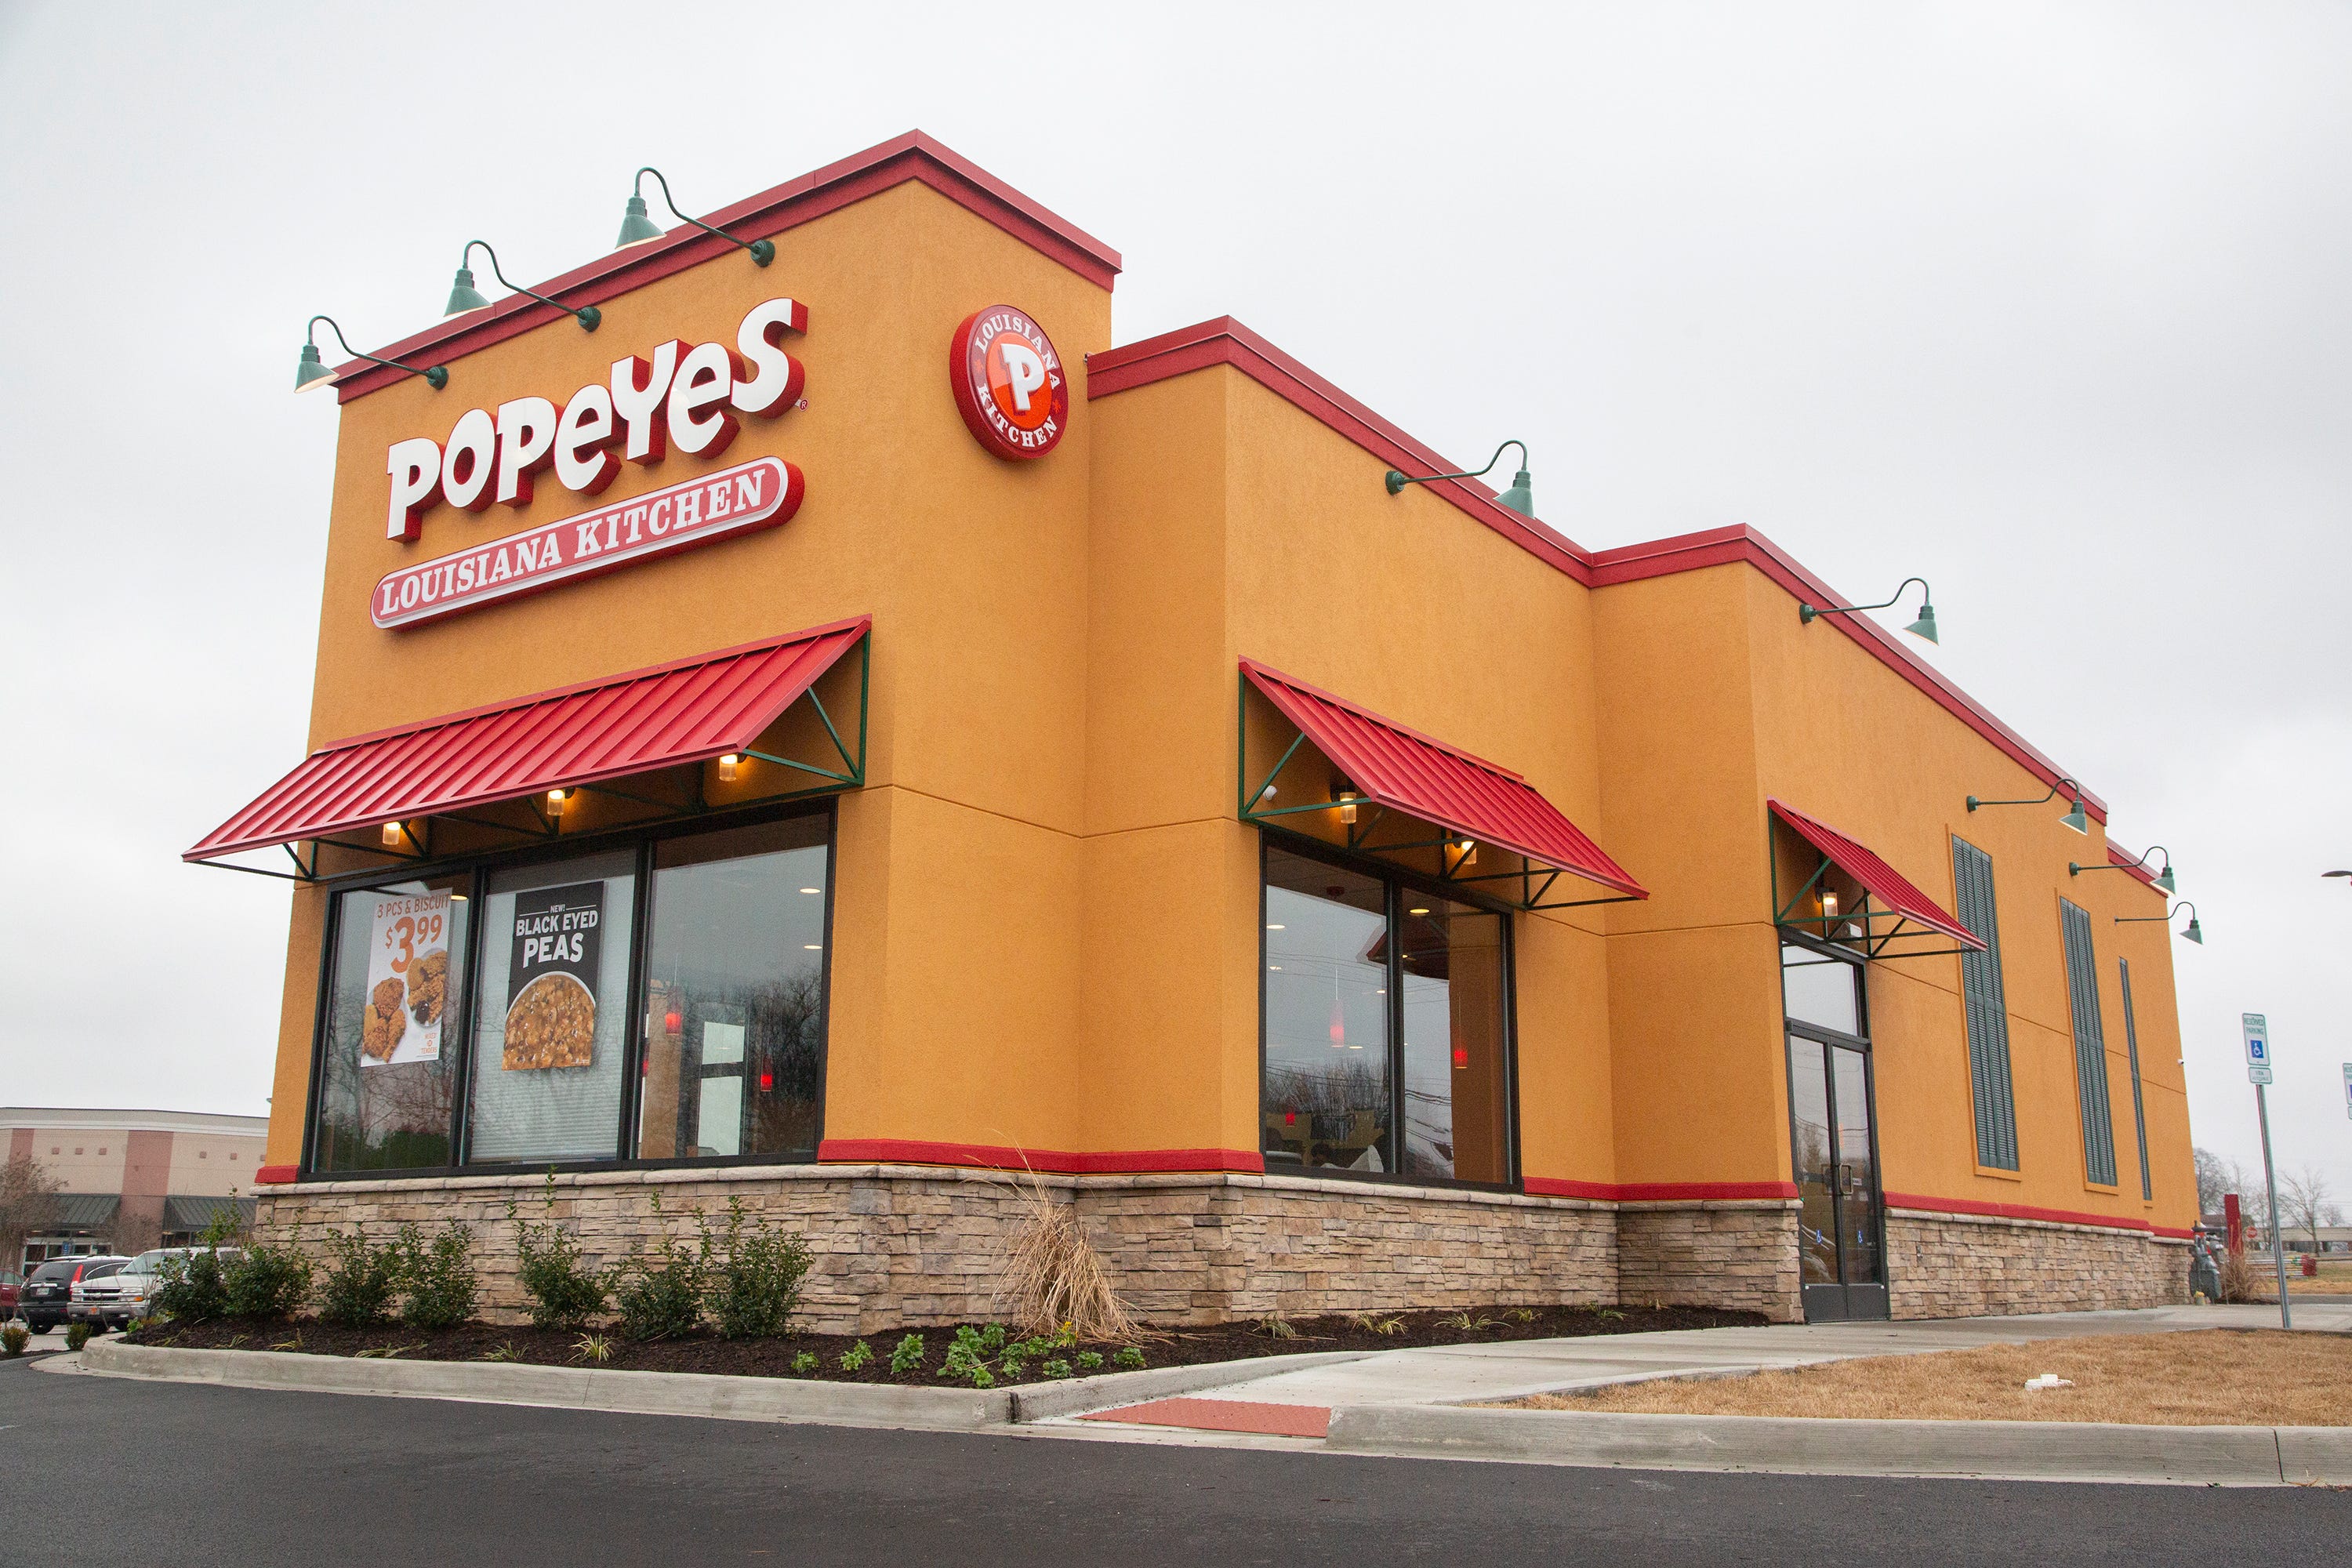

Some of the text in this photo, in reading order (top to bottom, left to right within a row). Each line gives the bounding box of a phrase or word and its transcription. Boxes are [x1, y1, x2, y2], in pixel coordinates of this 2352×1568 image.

[975, 314, 1061, 390] LOUISIANA
[1000, 343, 1046, 411] P
[978, 383, 1058, 448] KITCHEN
[379, 468, 768, 616] LOUISIANA KITCHEN
[377, 892, 449, 918] 3 PCS & BISCUIT
[516, 910, 598, 936] BLACK EYED
[550, 904, 565, 913] NEW!
[523, 932, 584, 968] PEAS
